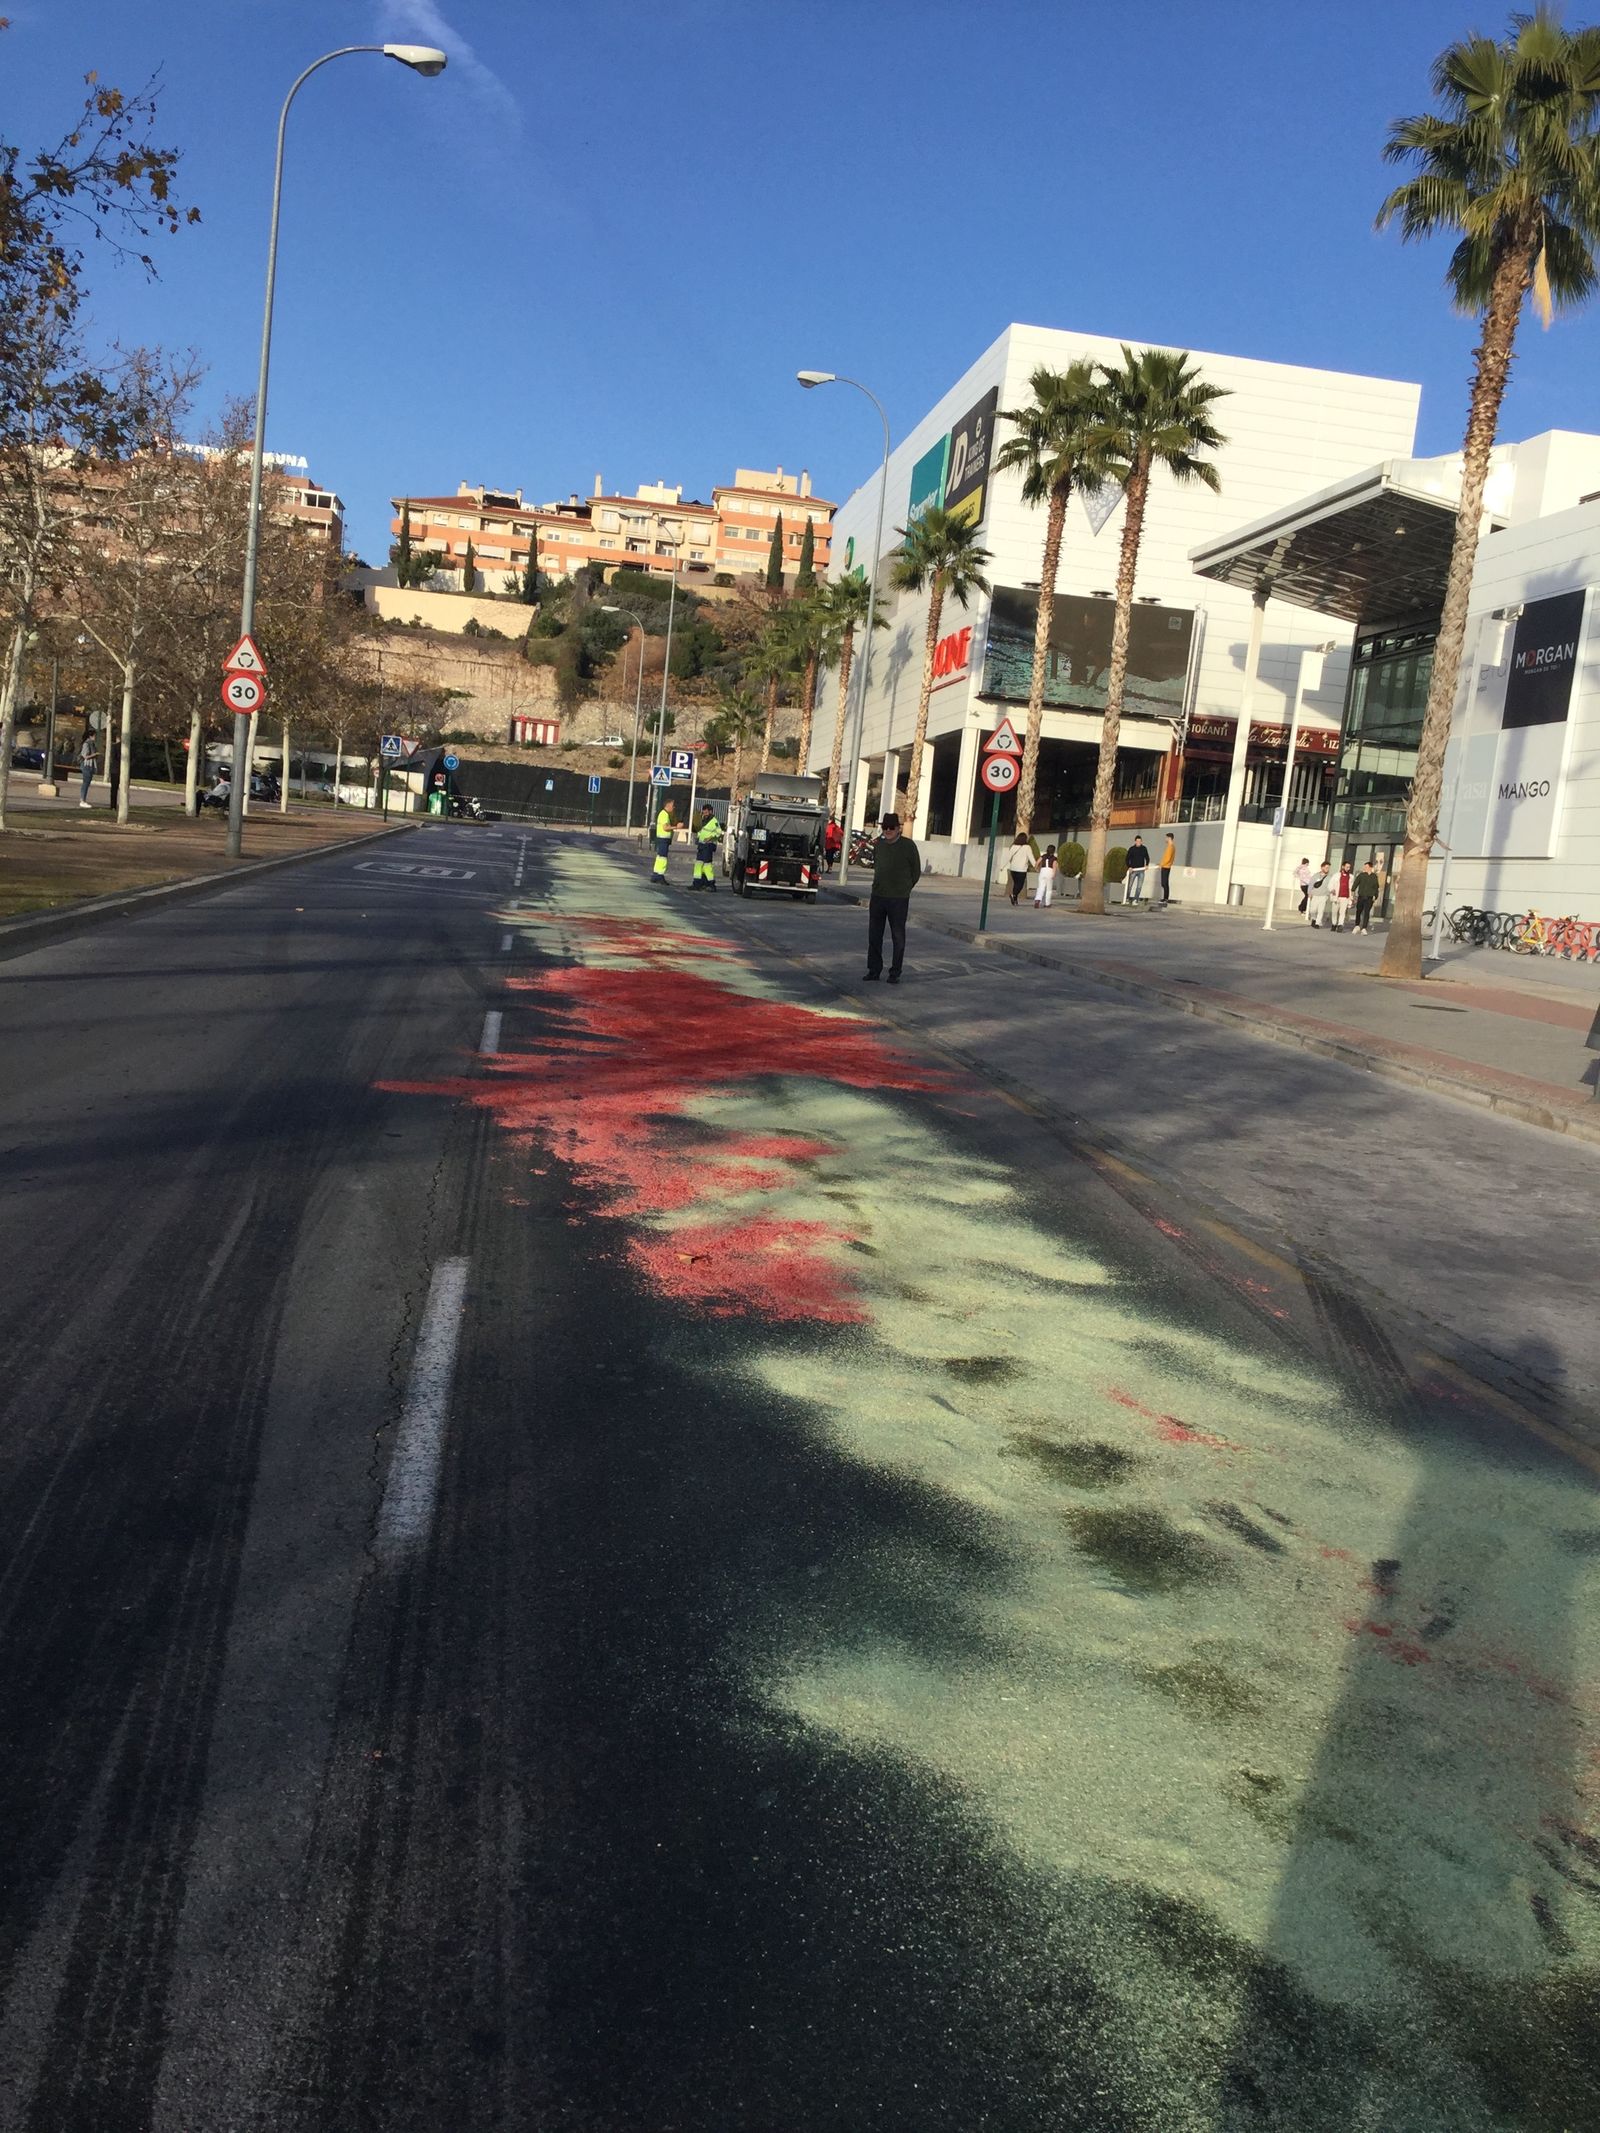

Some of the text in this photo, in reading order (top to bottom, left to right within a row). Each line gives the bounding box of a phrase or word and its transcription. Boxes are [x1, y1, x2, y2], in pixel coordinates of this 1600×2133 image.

[945, 431, 968, 499] JD
[1515, 642, 1575, 669] MORGAN
[232, 685, 255, 699] 30
[990, 765, 1012, 779] 30
[1498, 780, 1551, 800] MANGO
